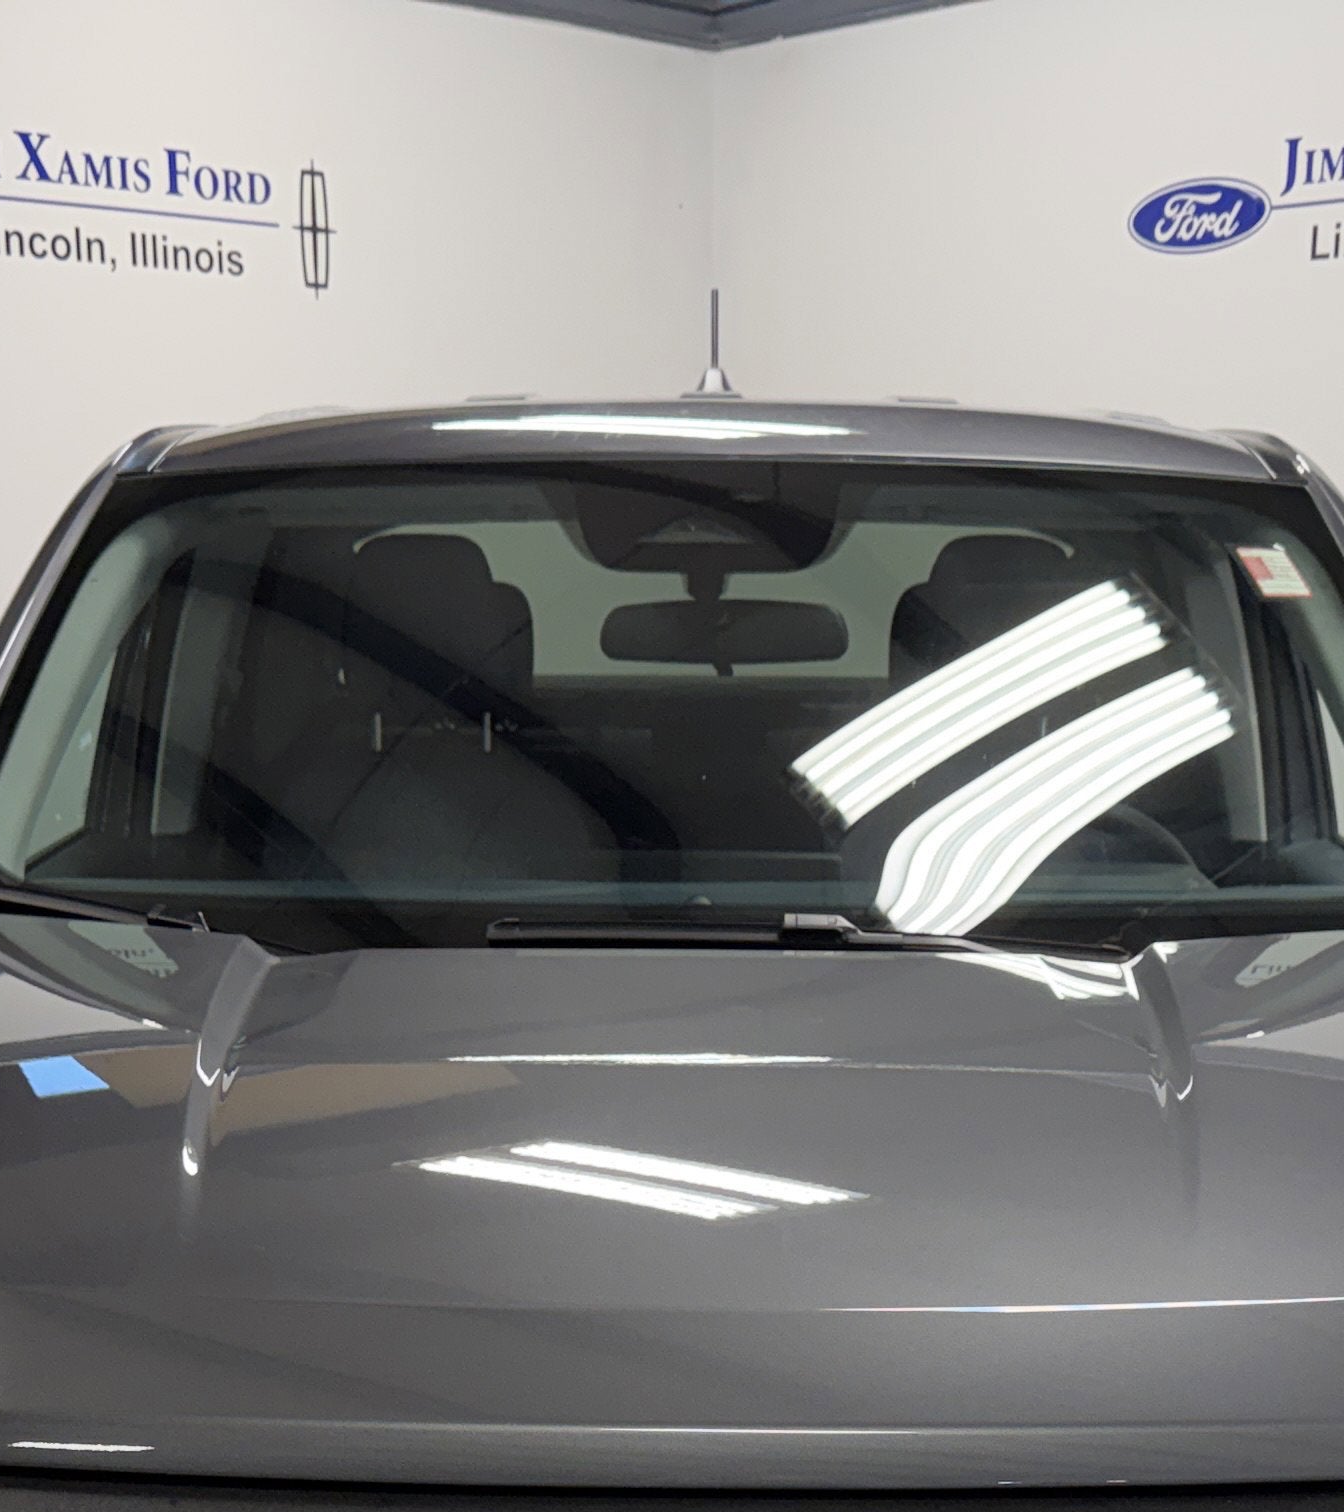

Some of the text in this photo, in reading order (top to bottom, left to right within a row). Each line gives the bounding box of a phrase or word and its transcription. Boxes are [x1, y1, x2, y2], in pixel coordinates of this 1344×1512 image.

[13, 130, 152, 193] XAMIS
[164, 148, 272, 206] FORD
[130, 232, 245, 277] Illinois
